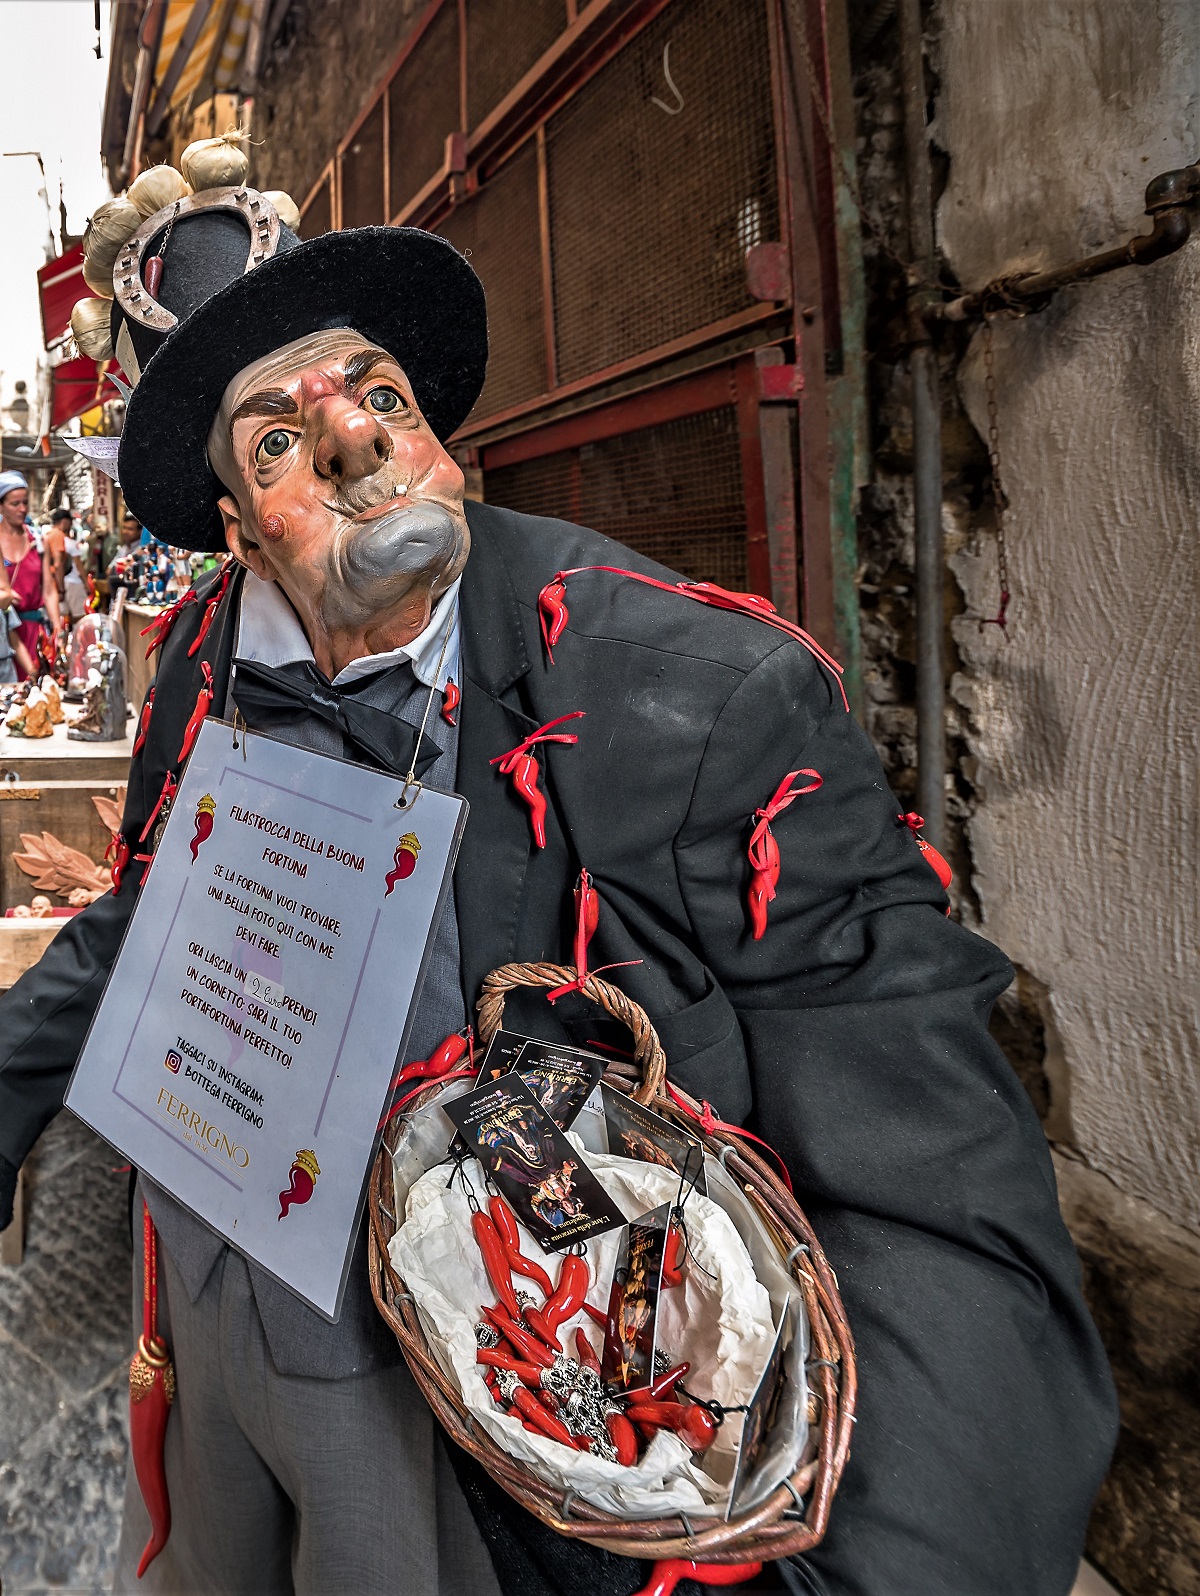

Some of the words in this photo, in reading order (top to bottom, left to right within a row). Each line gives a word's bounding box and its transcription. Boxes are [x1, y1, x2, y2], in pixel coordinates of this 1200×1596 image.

[229, 805, 291, 841] FILASTROCCA
[292, 830, 325, 856] DELLA
[325, 844, 366, 873] BUONA
[261, 847, 309, 879] FORTUNA
[213, 864, 225, 878] SE
[224, 868, 235, 883] LA
[235, 874, 274, 902] FORTUNA
[275, 893, 298, 914] VUOI
[299, 904, 342, 938] TROVARE,
[207, 885, 224, 902] UNA
[223, 893, 250, 917] BELLA
[250, 908, 275, 929] FOTO
[276, 921, 295, 939] QUI
[295, 930, 318, 951] CON
[318, 941, 335, 961] ME
[235, 924, 258, 947] DEVI
[257, 936, 281, 959] FARE.
[188, 941, 204, 958] ORA
[204, 949, 233, 976] LASCIA
[234, 967, 248, 984] UN
[186, 965, 199, 981] UN
[198, 974, 246, 1011] CORNETTO:
[246, 1003, 269, 1027] SARÀ
[269, 1015, 279, 1033] IL
[282, 1023, 303, 1045] TUO
[252, 977, 262, 999] 2
[263, 985, 283, 1009] Euro
[282, 995, 318, 1027] PRENDI
[180, 988, 243, 1037] PORTAFORTUNA
[243, 1028, 293, 1070] PERFETTO!
[175, 1036, 207, 1066] TAGGACI
[206, 1059, 218, 1072] SU
[217, 1065, 265, 1107] INSTAGRAM:
[533, 1069, 578, 1085] FERRIGNO
[184, 1065, 222, 1100] BOTTEGA
[221, 1091, 264, 1129] FERRIGNO
[156, 1087, 250, 1168] FERRIGNO
[480, 1107, 524, 1132] FERRIGNO
[551, 1227, 578, 1242] terracotta
[558, 1213, 591, 1229] Napoletana
[577, 1221, 592, 1232] della
[592, 1215, 611, 1227] L'Arte
